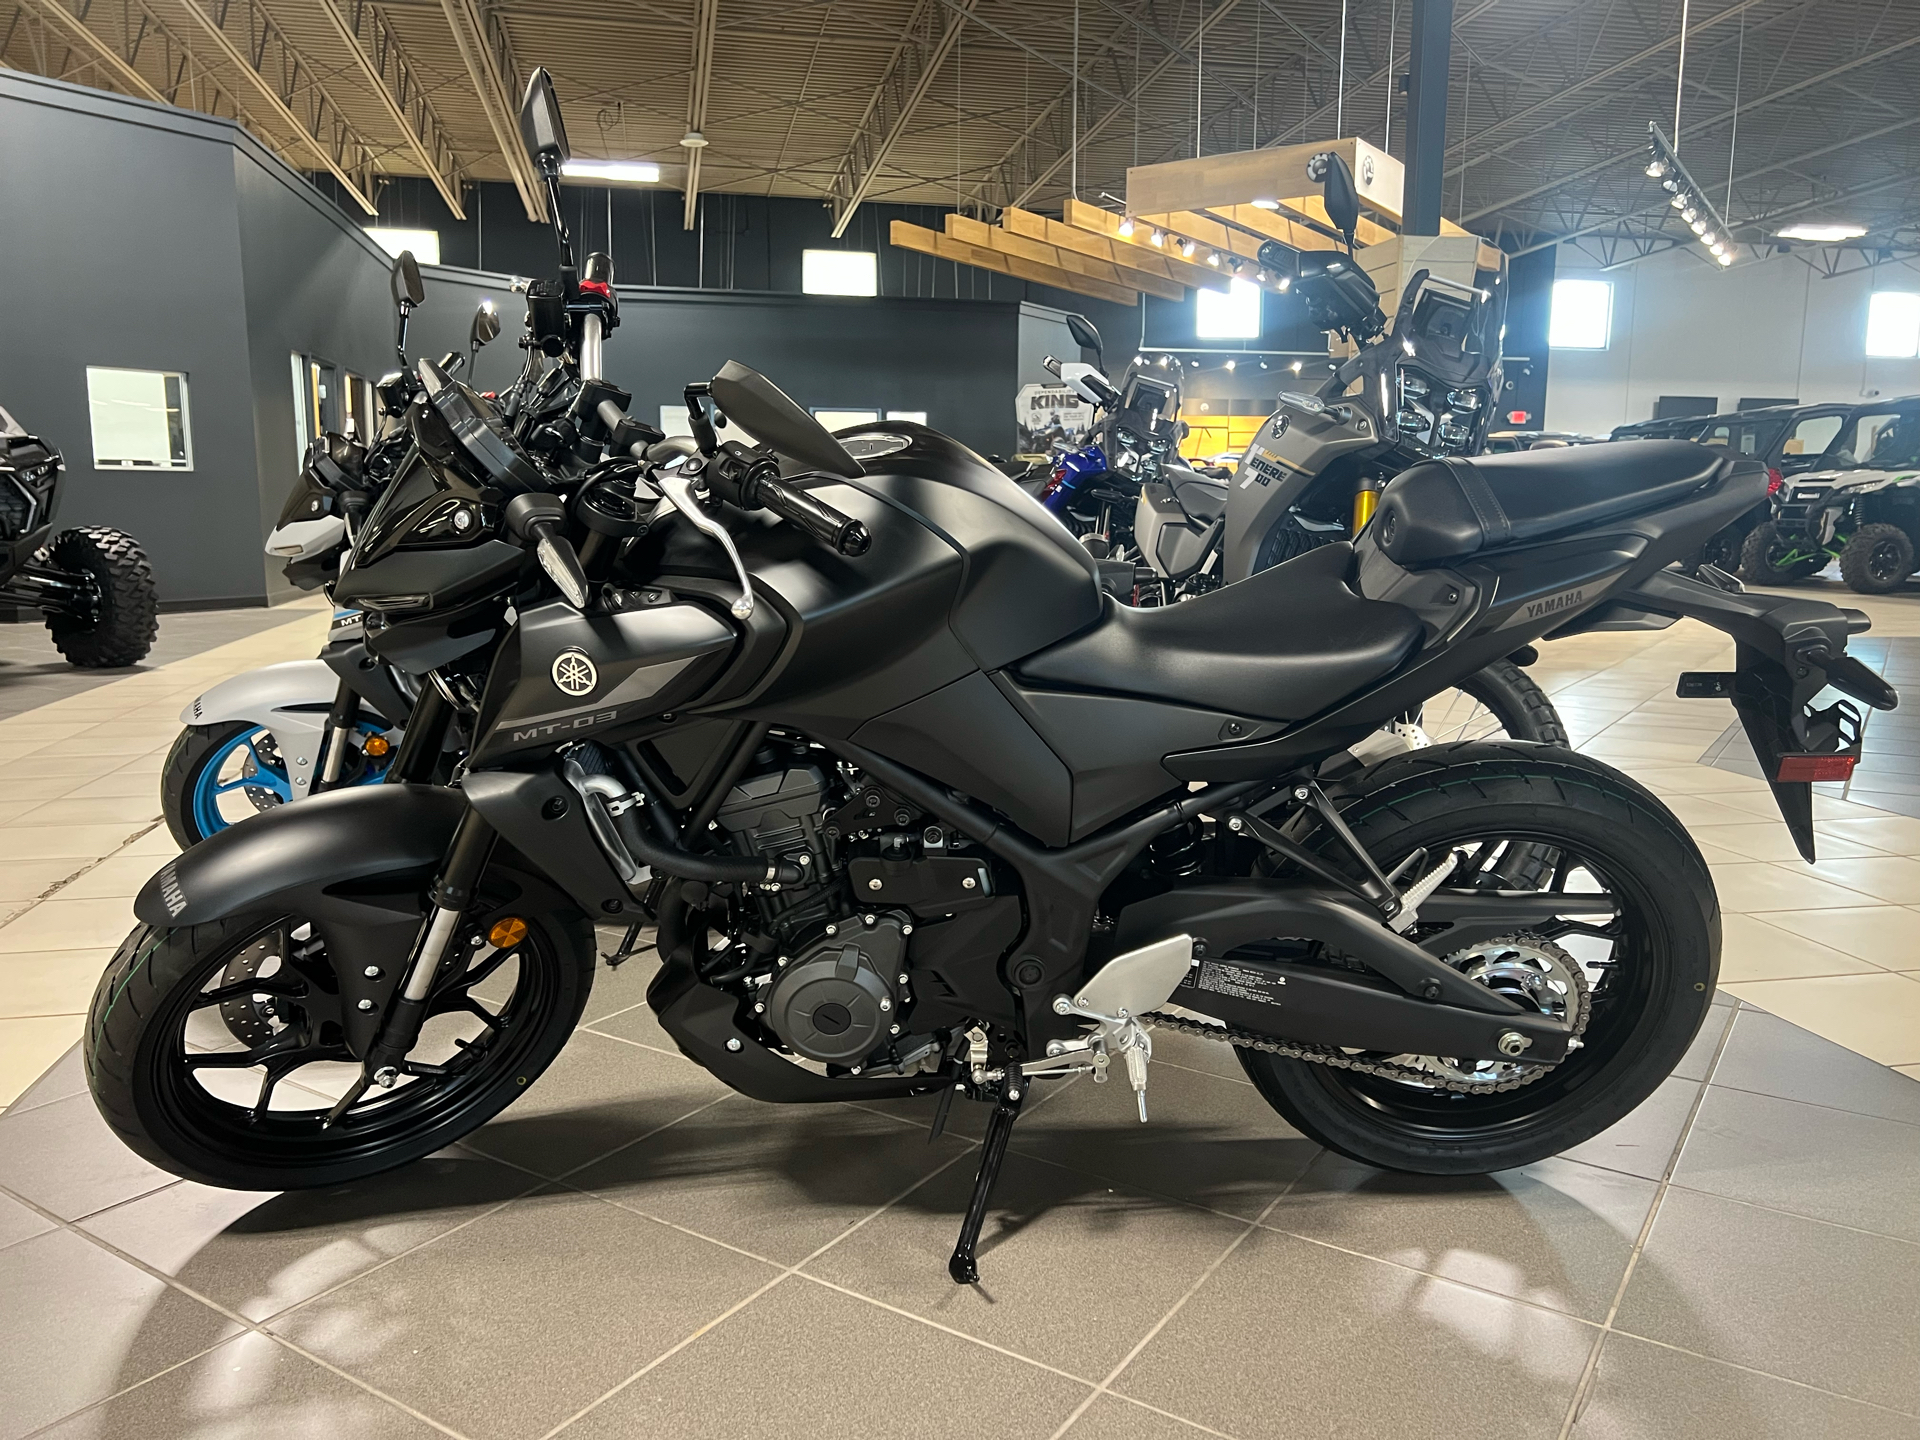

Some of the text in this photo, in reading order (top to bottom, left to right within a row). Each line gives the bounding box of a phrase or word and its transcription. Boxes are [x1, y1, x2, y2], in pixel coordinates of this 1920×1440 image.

[1030, 394, 1079, 411] KING
[1240, 467, 1271, 490] 700
[1527, 590, 1583, 618] YAMAHA
[513, 710, 617, 742] MT-03
